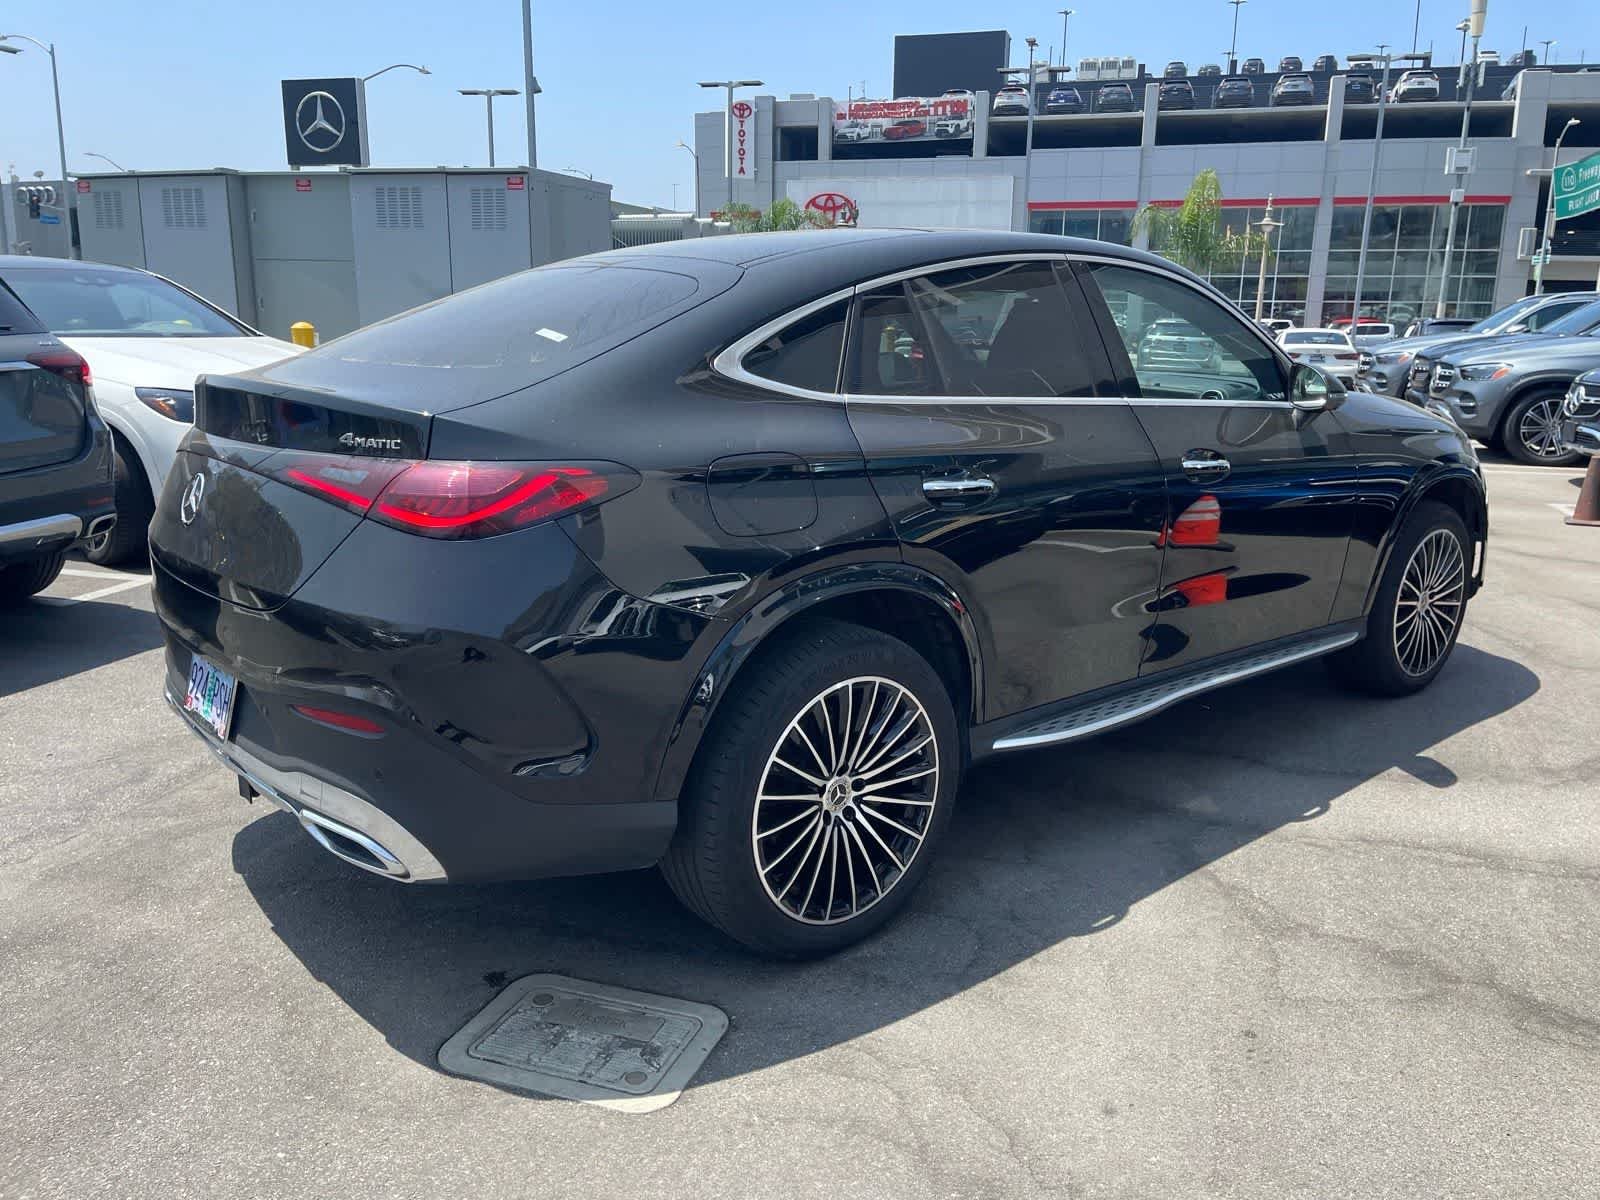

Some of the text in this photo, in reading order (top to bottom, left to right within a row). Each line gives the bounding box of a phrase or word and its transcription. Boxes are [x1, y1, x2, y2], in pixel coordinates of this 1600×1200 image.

[738, 120, 746, 175] TOYOTA
[1564, 175, 1575, 187] 110
[339, 432, 401, 449] 4MATIC
[188, 662, 232, 724] 924 PSH
